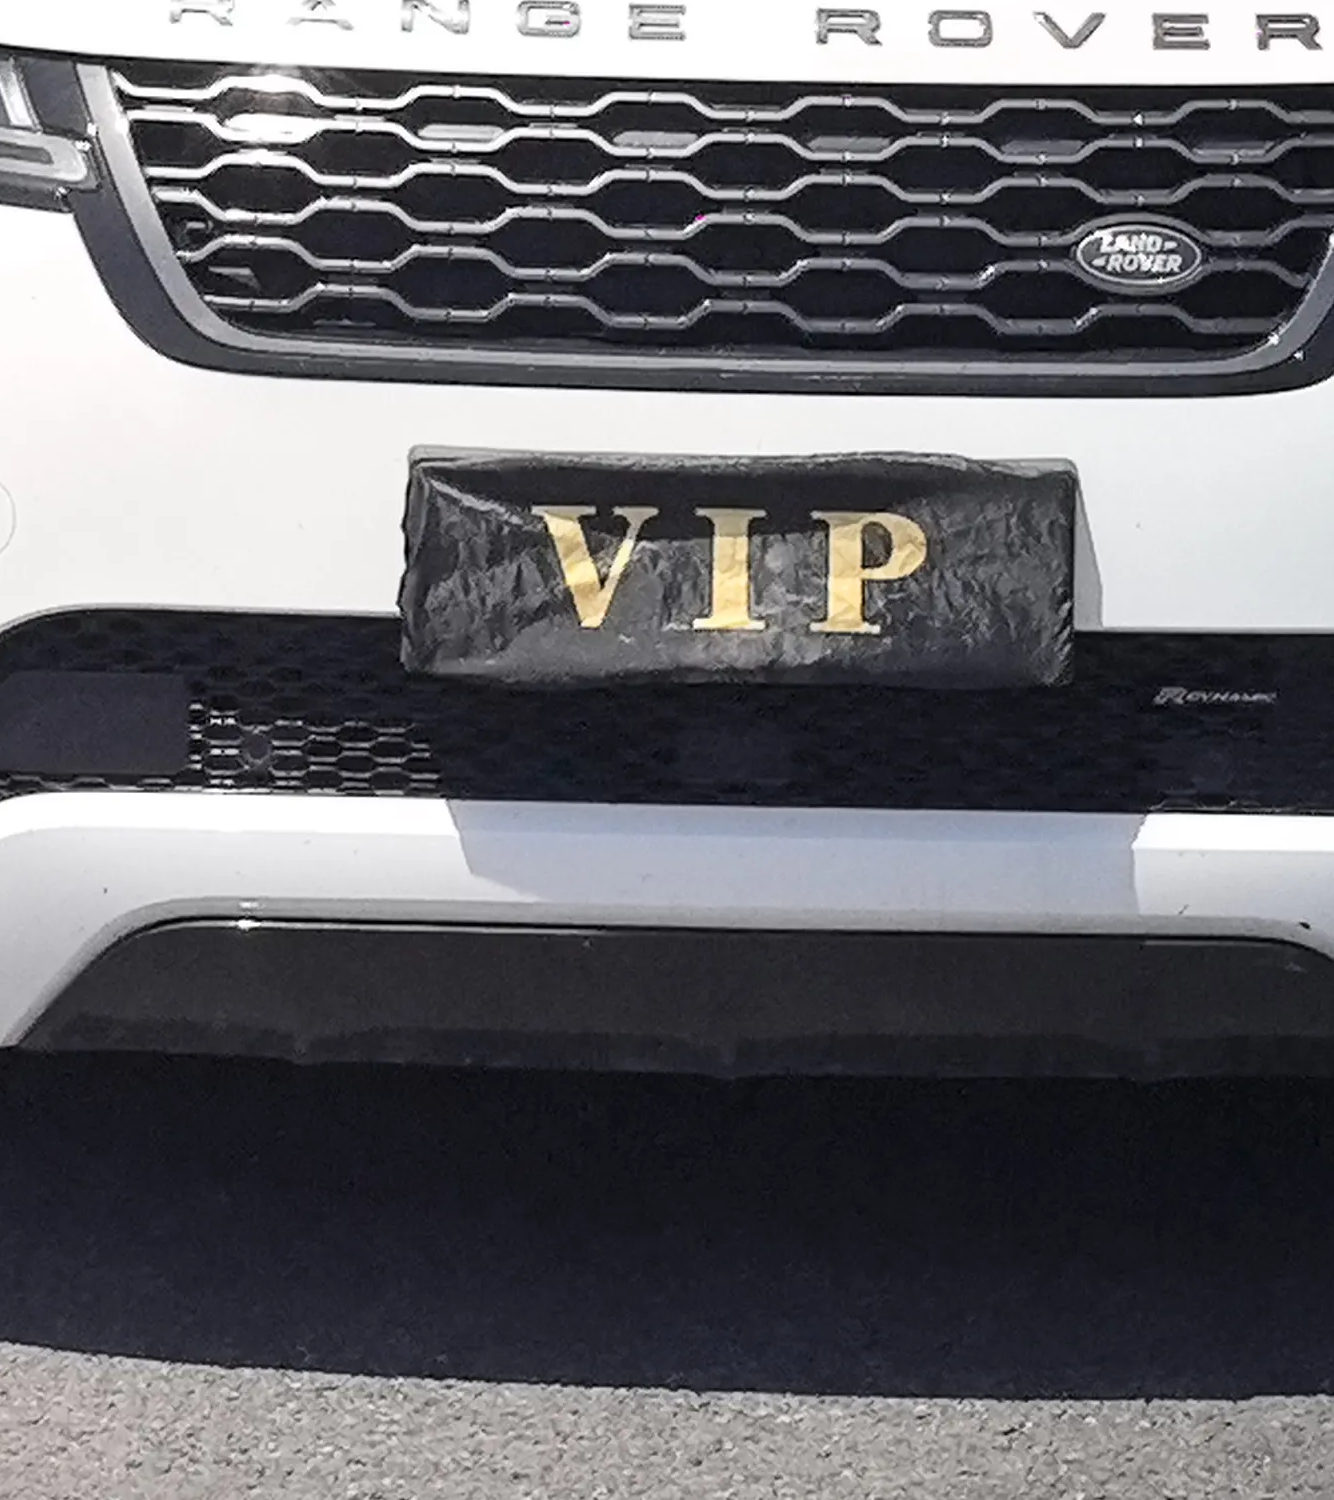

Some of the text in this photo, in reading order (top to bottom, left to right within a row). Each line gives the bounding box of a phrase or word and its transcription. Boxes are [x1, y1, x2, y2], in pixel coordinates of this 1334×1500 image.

[815, 7, 1324, 52] ROVER
[1105, 252, 1183, 274] ROVER
[530, 504, 929, 635] VIP
